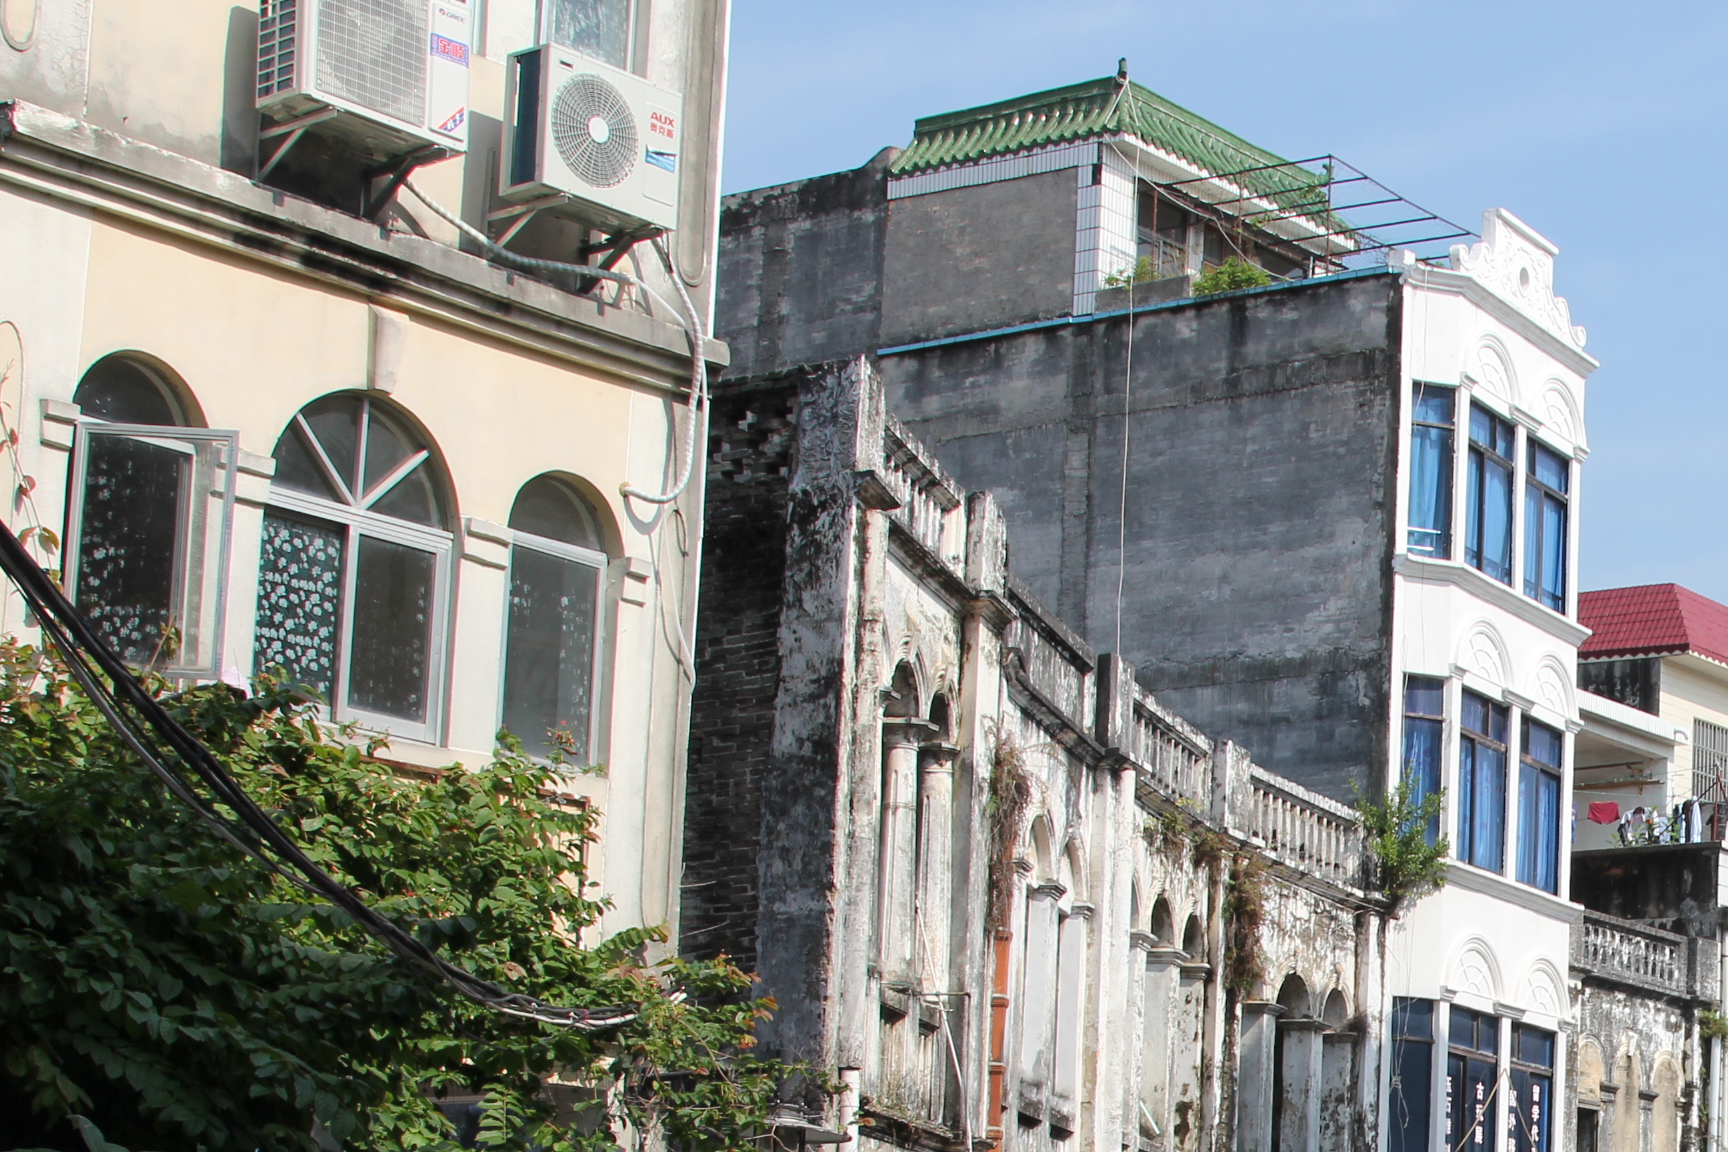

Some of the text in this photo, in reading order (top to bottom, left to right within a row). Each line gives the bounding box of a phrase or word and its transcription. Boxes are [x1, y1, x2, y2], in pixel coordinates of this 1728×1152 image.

[650, 111, 675, 128] AUX
[650, 122, 674, 139] 奥克斯
